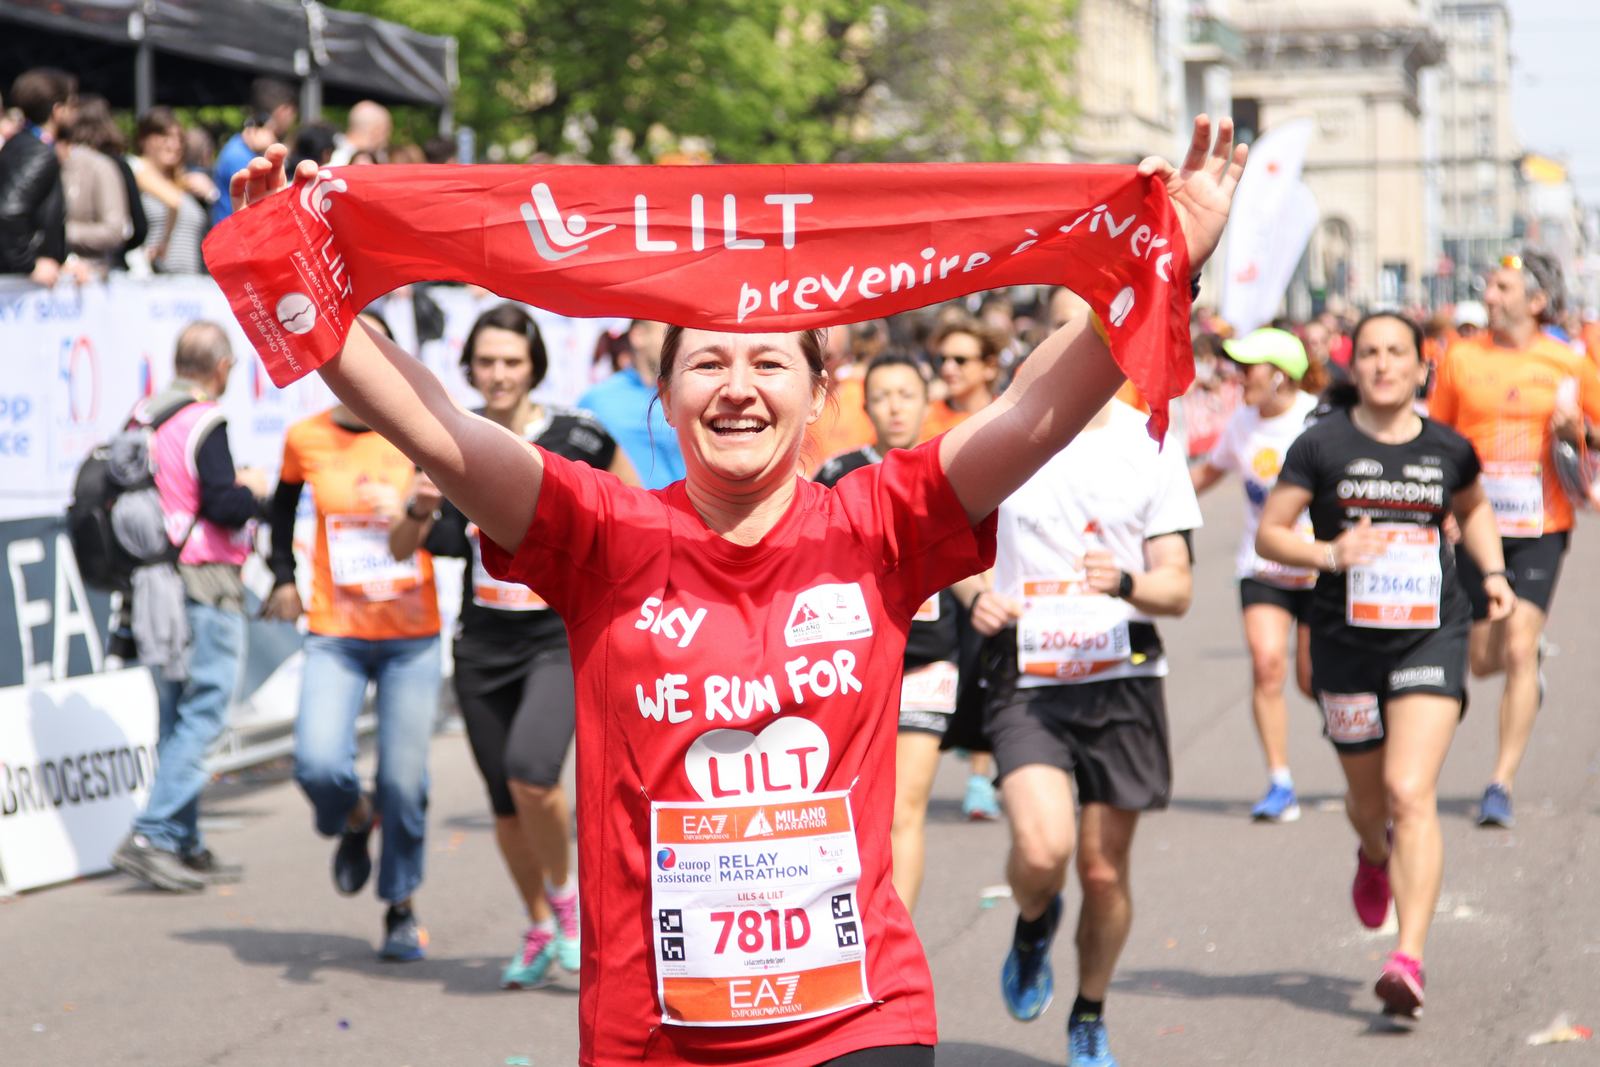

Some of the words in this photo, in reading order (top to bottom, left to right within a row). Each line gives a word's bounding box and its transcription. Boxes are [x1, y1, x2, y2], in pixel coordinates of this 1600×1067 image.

[634, 193, 814, 252] LILT
[737, 247, 991, 323] prevenire
[243, 281, 270, 326] SEZIONE
[264, 317, 301, 374] PROVINCIALE
[249, 311, 260, 324] DI
[254, 319, 279, 353] MILANO
[7, 532, 105, 686] EA
[635, 672, 693, 724] WE
[703, 674, 781, 723] RUN
[784, 649, 863, 704] FOR
[708, 746, 819, 798] LILT
[682, 814, 728, 834] EA7
[775, 806, 827, 823] MILANO
[775, 817, 828, 833] MARATHON
[678, 860, 711, 872] europ
[719, 852, 779, 869] RELAY
[656, 873, 712, 884] assistance
[719, 864, 809, 882] MARATHON
[737, 890, 757, 902] LILS
[758, 890, 766, 901] 4
[766, 890, 785, 900] LILT
[709, 907, 812, 955] 781D
[728, 974, 801, 1009] EA7
[730, 1007, 767, 1018] EMPORIO
[773, 1003, 803, 1016] ARMANI
